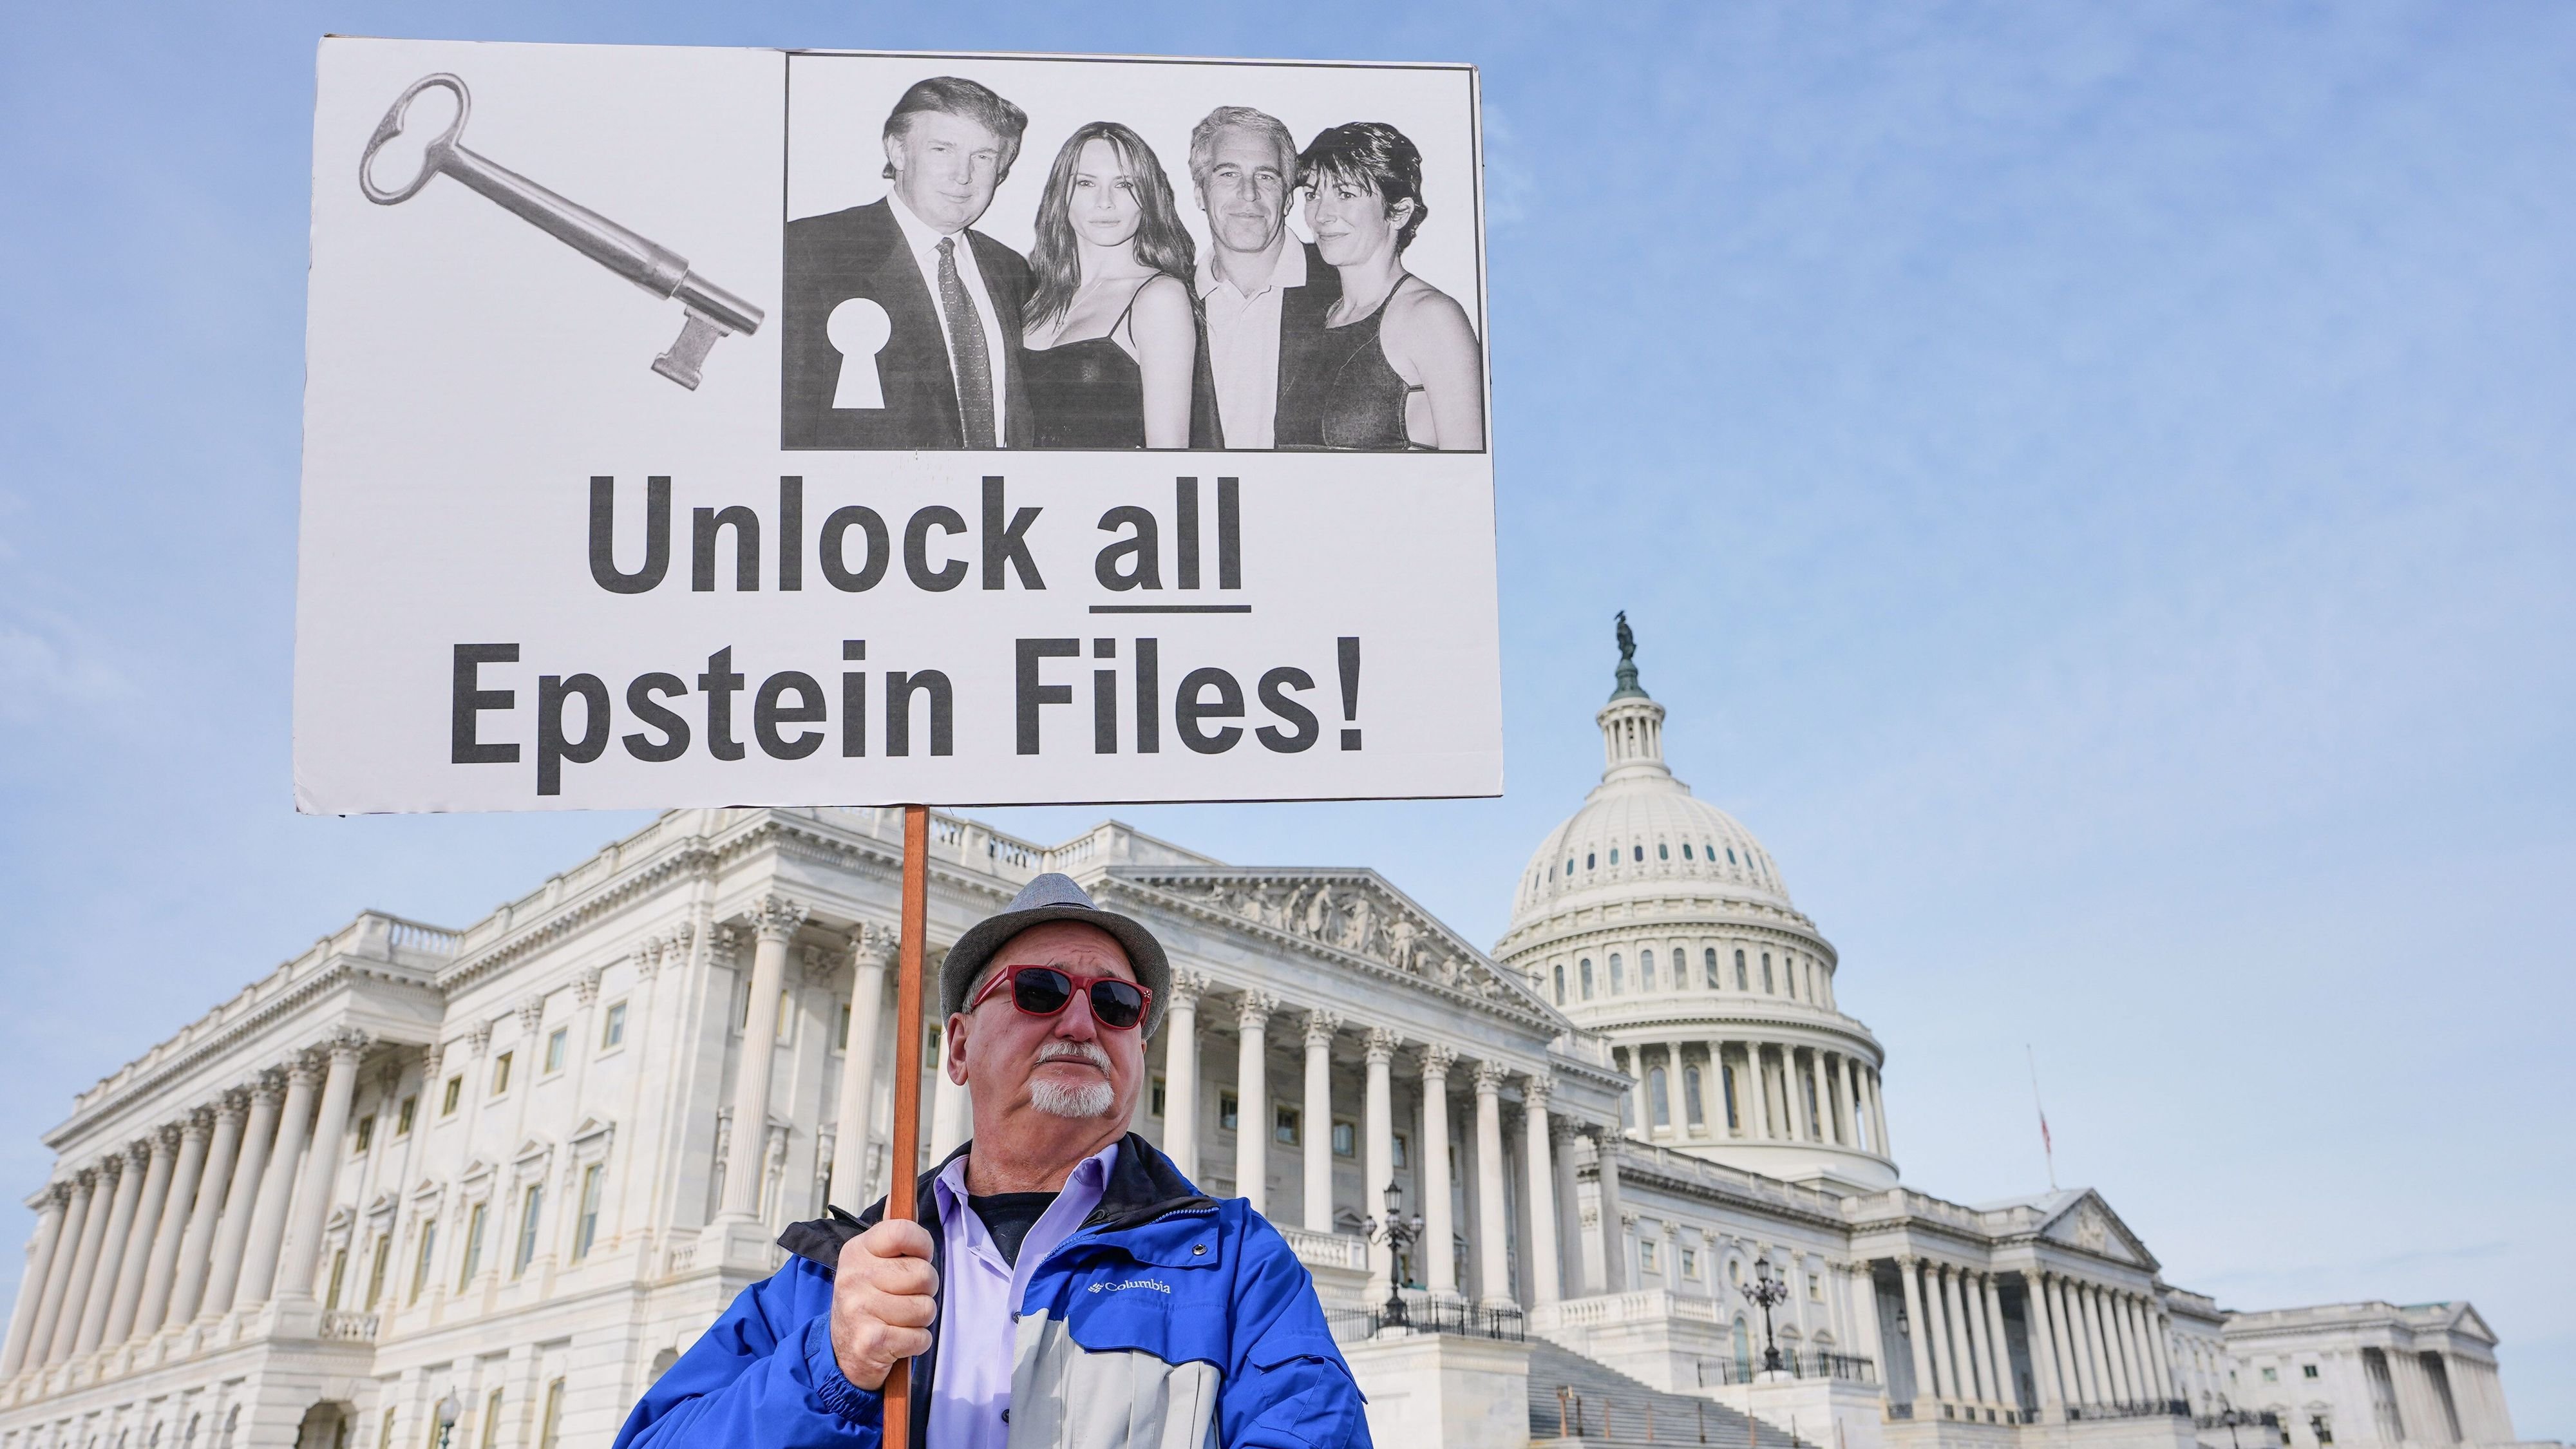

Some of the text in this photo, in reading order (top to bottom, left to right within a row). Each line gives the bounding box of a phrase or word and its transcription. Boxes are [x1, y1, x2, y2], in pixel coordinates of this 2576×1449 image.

[589, 475, 1242, 594] Unlock all
[451, 636, 1362, 796] Epstein Files!
[1104, 1278, 1171, 1294] Columbia
